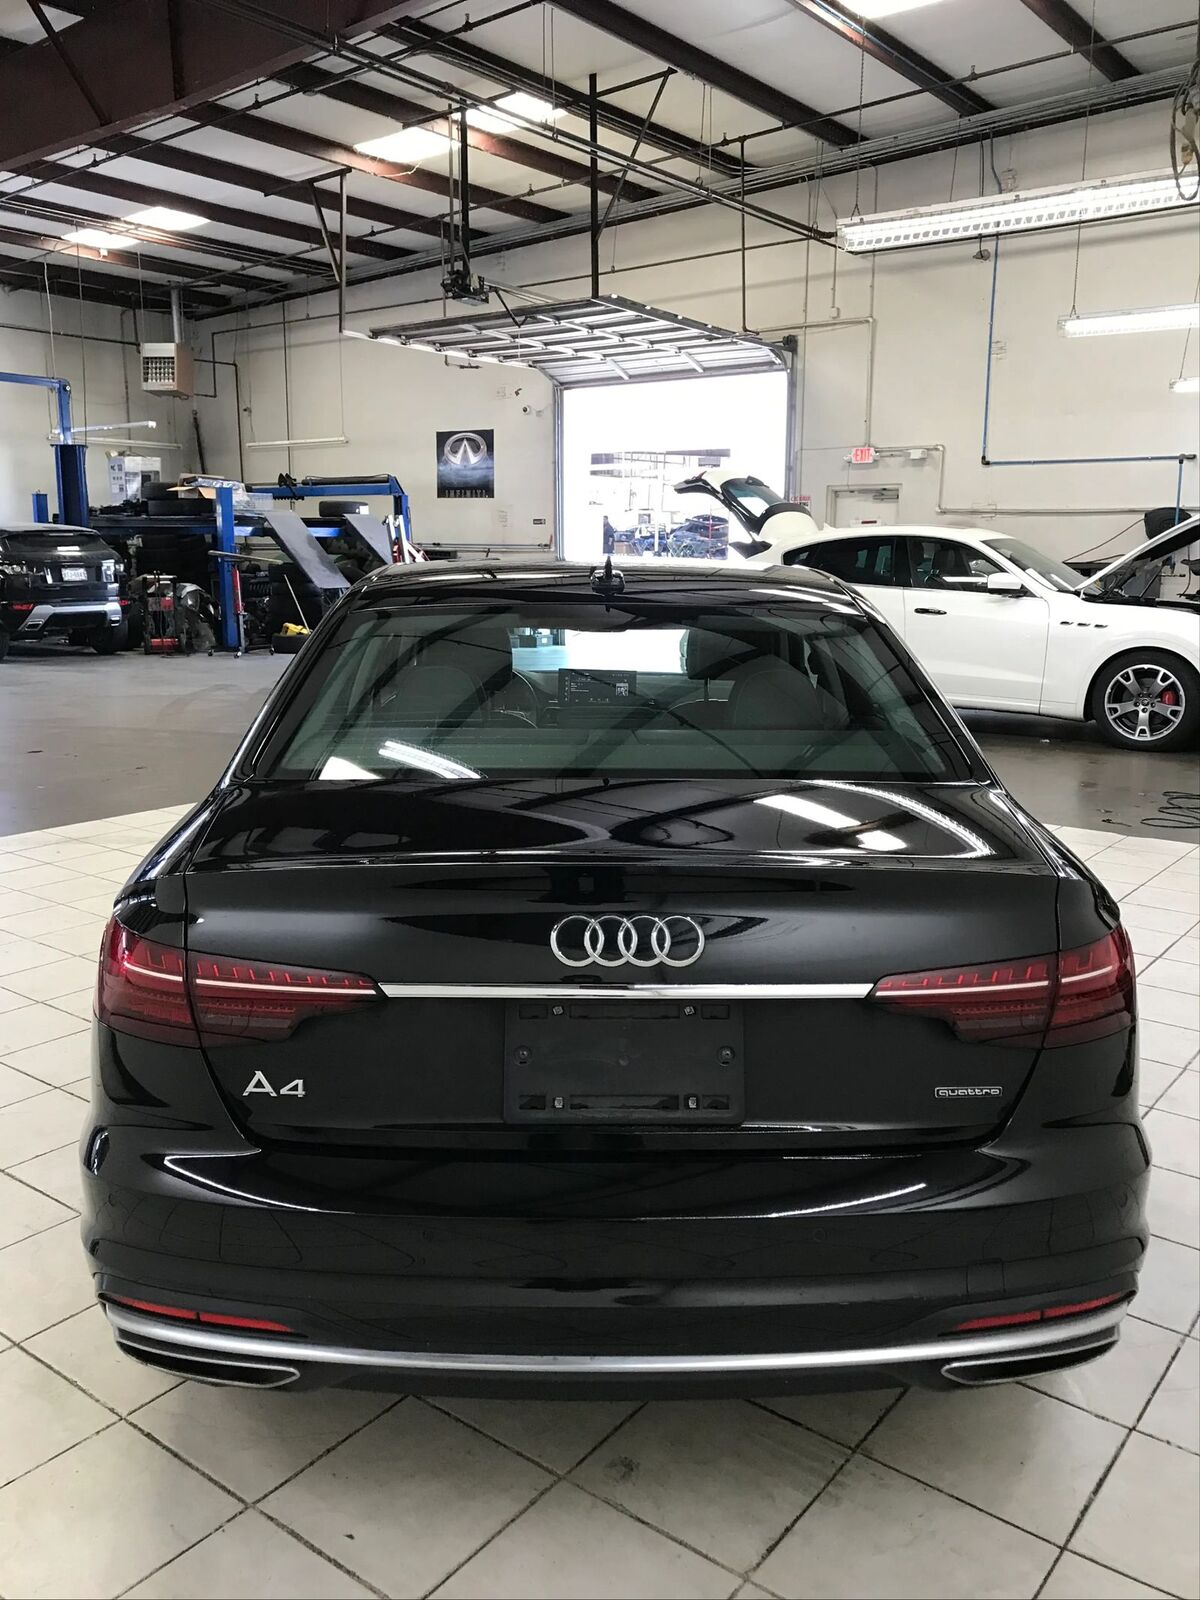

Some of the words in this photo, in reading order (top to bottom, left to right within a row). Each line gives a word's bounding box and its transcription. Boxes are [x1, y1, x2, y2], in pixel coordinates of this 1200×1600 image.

[855, 448, 871, 462] EXIT
[242, 1070, 306, 1098] A4
[938, 1087, 1000, 1097] quattro
